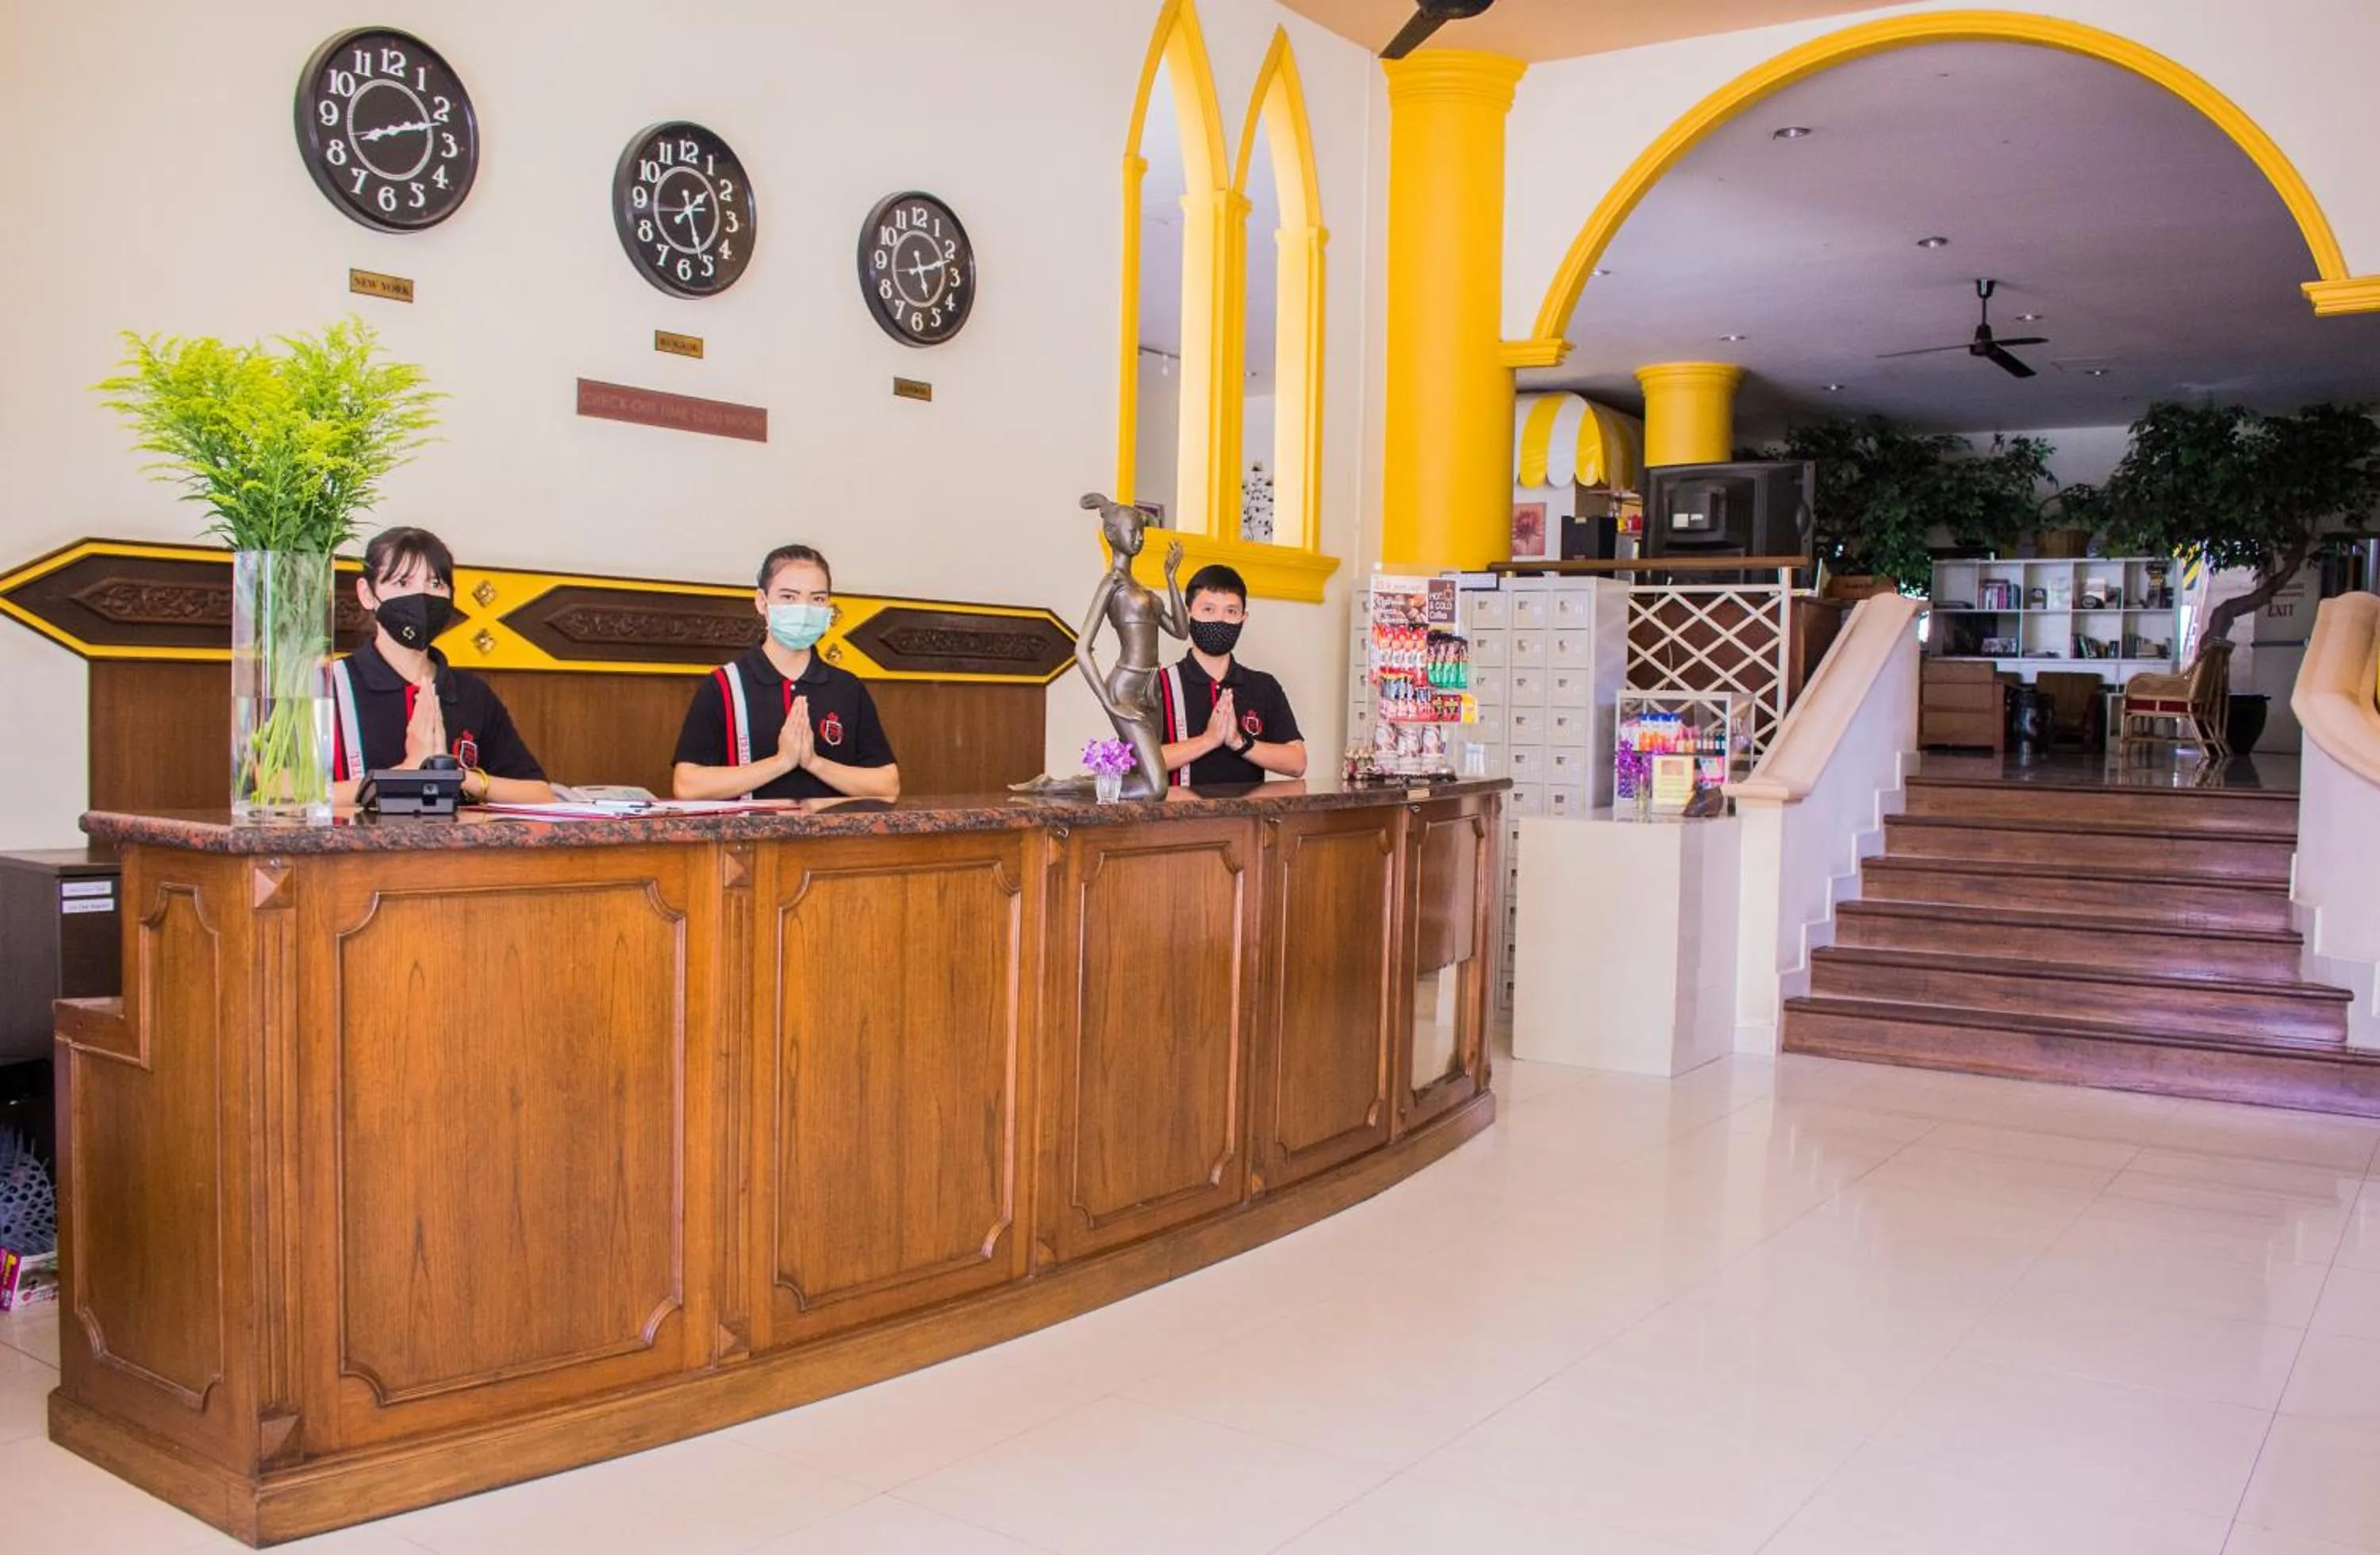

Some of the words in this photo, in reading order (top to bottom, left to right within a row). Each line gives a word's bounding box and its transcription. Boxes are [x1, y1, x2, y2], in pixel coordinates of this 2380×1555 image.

[355, 50, 373, 77] 11
[381, 48, 406, 77] 12
[328, 69, 355, 97] 10
[416, 67, 426, 91] 1
[319, 100, 339, 126] 9
[433, 96, 450, 122] 2
[326, 139, 347, 165] 8
[441, 132, 458, 158] 3
[658, 142, 673, 165] 11
[679, 140, 698, 164] 12
[432, 164, 448, 189] 4
[639, 159, 660, 183] 10
[706, 155, 714, 176] 1
[351, 168, 369, 194] 7
[720, 179, 732, 202] 2
[378, 186, 396, 212] 6
[409, 182, 425, 208] 5
[633, 186, 647, 208] 9
[726, 210, 739, 232] 3
[896, 209, 908, 229] 11
[912, 207, 927, 228] 12
[935, 218, 939, 237] 1
[637, 220, 654, 242] 8
[881, 225, 897, 246] 10
[657, 244, 670, 267] 7
[719, 239, 731, 260] 4
[874, 250, 887, 269] 9
[945, 240, 955, 259] 2
[677, 259, 692, 280] 6
[701, 255, 713, 277] 5
[354, 275, 377, 290] NEW
[879, 279, 892, 298] 8
[950, 268, 961, 287] 3
[894, 300, 905, 320] 7
[945, 293, 955, 311] 4
[912, 312, 923, 331] 6
[931, 307, 941, 327] 5
[2267, 604, 2294, 617] EXIT
